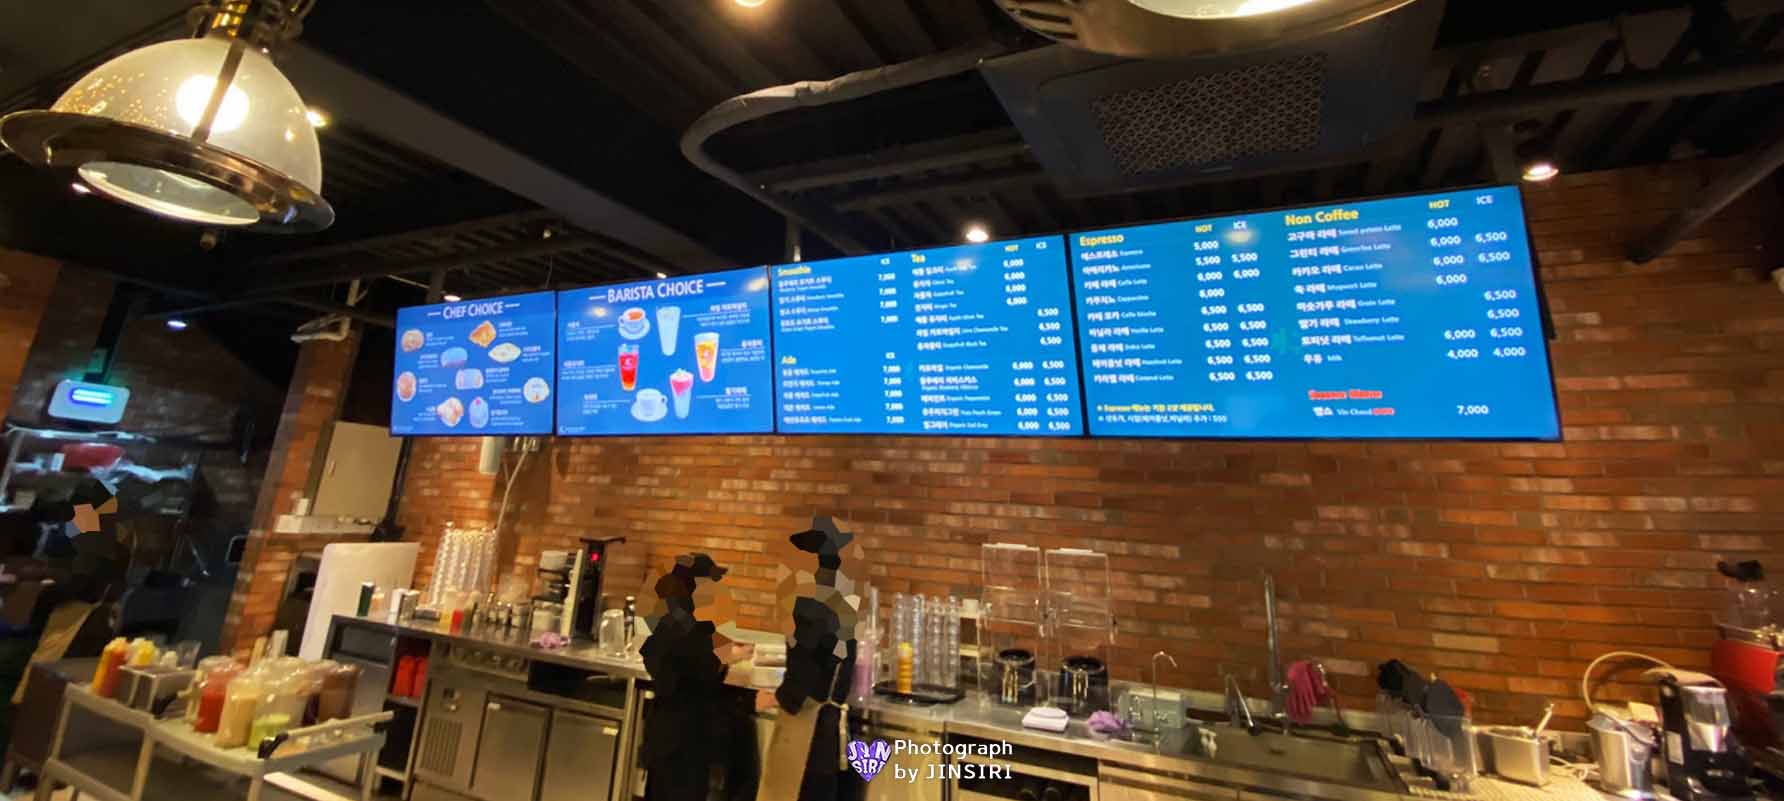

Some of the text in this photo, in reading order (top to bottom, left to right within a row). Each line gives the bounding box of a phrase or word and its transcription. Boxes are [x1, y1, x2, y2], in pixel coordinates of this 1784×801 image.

[1429, 195, 1493, 208] HOT ICE
[1285, 209, 1359, 226] Non Coffee
[1428, 217, 1458, 229] 6,000
[1195, 225, 1212, 233] HOT
[1080, 234, 1124, 246] Espresso
[1288, 231, 1315, 241] 고구마
[1317, 229, 1336, 238] 라떼
[1431, 232, 1507, 247] 6,000 6,500
[1194, 241, 1219, 251] 5,000
[1290, 248, 1317, 258] 그린티
[1320, 246, 1339, 256] 라떼
[911, 254, 925, 263] Tea
[1195, 253, 1258, 266] 5,500 5,500
[1433, 251, 1510, 266] 6,000 6,500
[1233, 269, 1260, 279] 6,000
[1292, 266, 1320, 276] 카카오
[1322, 264, 1342, 274] 라떼
[1436, 274, 1467, 285] 6,000
[608, 280, 704, 303] BARISTA CHOICE
[1306, 284, 1325, 293] 라떼
[1484, 290, 1516, 301] 6,500
[1201, 304, 1264, 315] 6,500 6,500
[1336, 299, 1356, 309] 라떼
[443, 302, 503, 319] CHEF CHOICE
[1037, 308, 1059, 317] 6,500
[1487, 308, 1519, 319] 6,500
[1039, 322, 1060, 331] 6,500
[1203, 321, 1266, 333] 6,500 6,500
[1298, 318, 1318, 329] 딸기
[1320, 318, 1340, 328] 라떼
[1444, 327, 1523, 340] 6,000 6,500
[1040, 336, 1062, 345] 6,500
[1205, 338, 1269, 349] 6,500 6,500
[1302, 336, 1330, 345] 토피넛
[1332, 335, 1352, 344] 라떼
[1448, 347, 1526, 359] 4,000 4,000
[1208, 354, 1271, 365] 6,500 6,500
[1209, 371, 1273, 382] 6,500 6,500
[1457, 405, 1489, 415] 7,000
